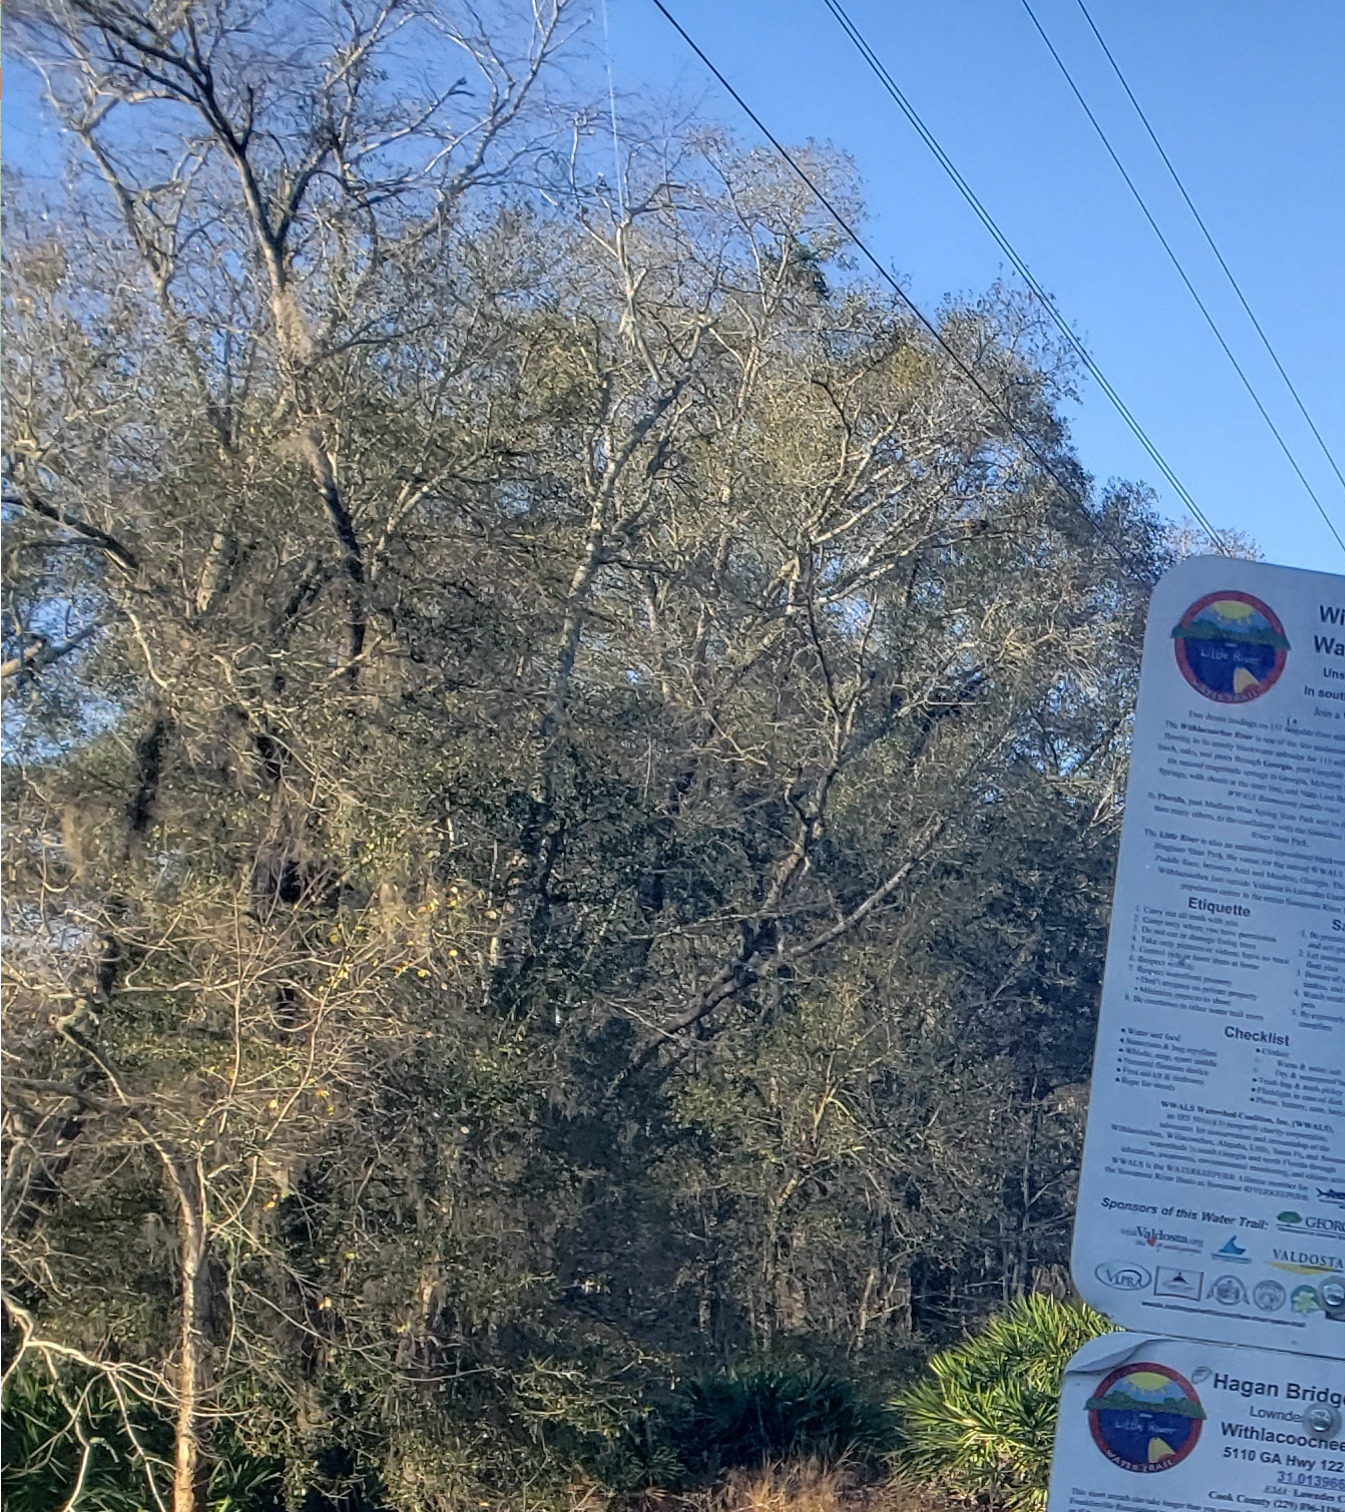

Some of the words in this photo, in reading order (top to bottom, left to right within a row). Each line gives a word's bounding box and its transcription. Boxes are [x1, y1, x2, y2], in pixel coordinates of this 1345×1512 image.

[1313, 706, 1332, 719] Join
[1188, 897, 1251, 918] Etiquette
[1224, 1026, 1290, 1047] Checklist
[1101, 1197, 1158, 1215] Sponsors
[1160, 1206, 1174, 1216] of
[1176, 1209, 1198, 1220] this
[1201, 1211, 1235, 1225] Water
[1239, 1216, 1268, 1231] Trail:
[1272, 1248, 1344, 1269] VALDOSTA
[1213, 1372, 1279, 1398] Hagan
[1223, 1446, 1256, 1461] 5110
[1260, 1452, 1282, 1465] GA
[1285, 1454, 1316, 1471] Hwy
[1320, 1460, 1344, 1473] 122
[1236, 1494, 1270, 1508] County
[1293, 1488, 1335, 1501] Lowndes
